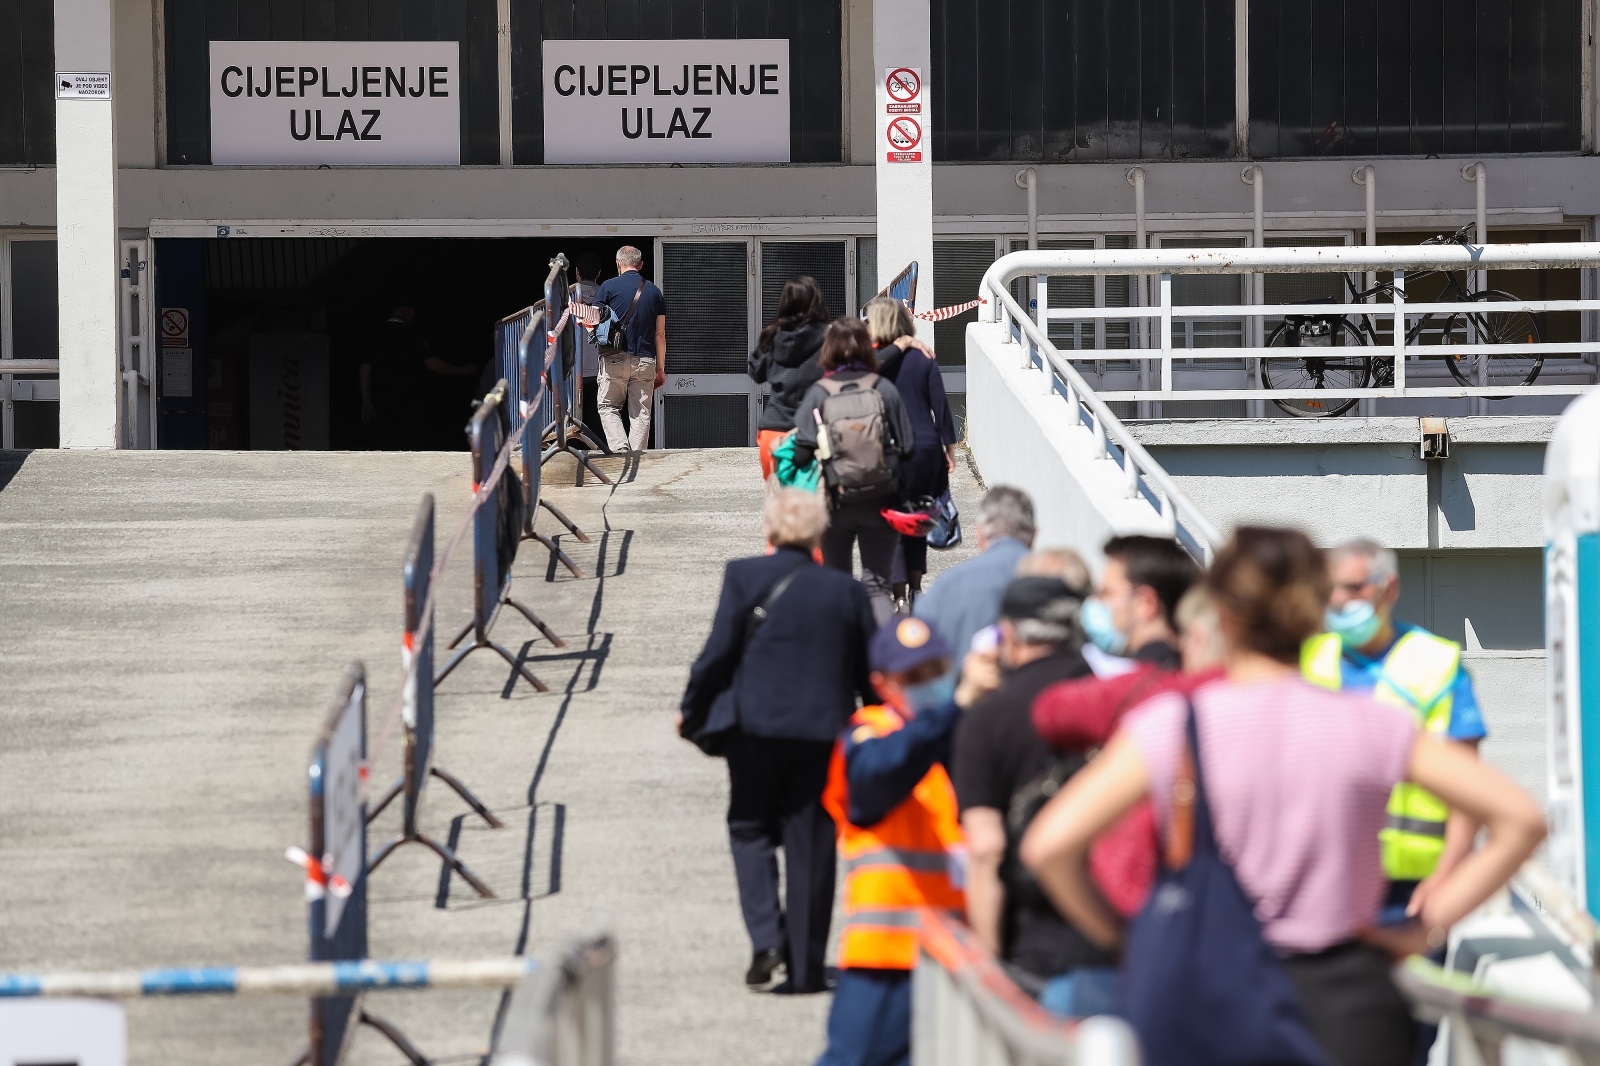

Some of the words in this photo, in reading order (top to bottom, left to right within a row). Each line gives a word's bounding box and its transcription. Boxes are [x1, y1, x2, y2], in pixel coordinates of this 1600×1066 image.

[221, 66, 448, 98] CIJEPLJENJE
[555, 64, 778, 97] CIJEPLJENJE
[290, 109, 382, 141] ULAZ
[622, 107, 712, 140] ULAZ
